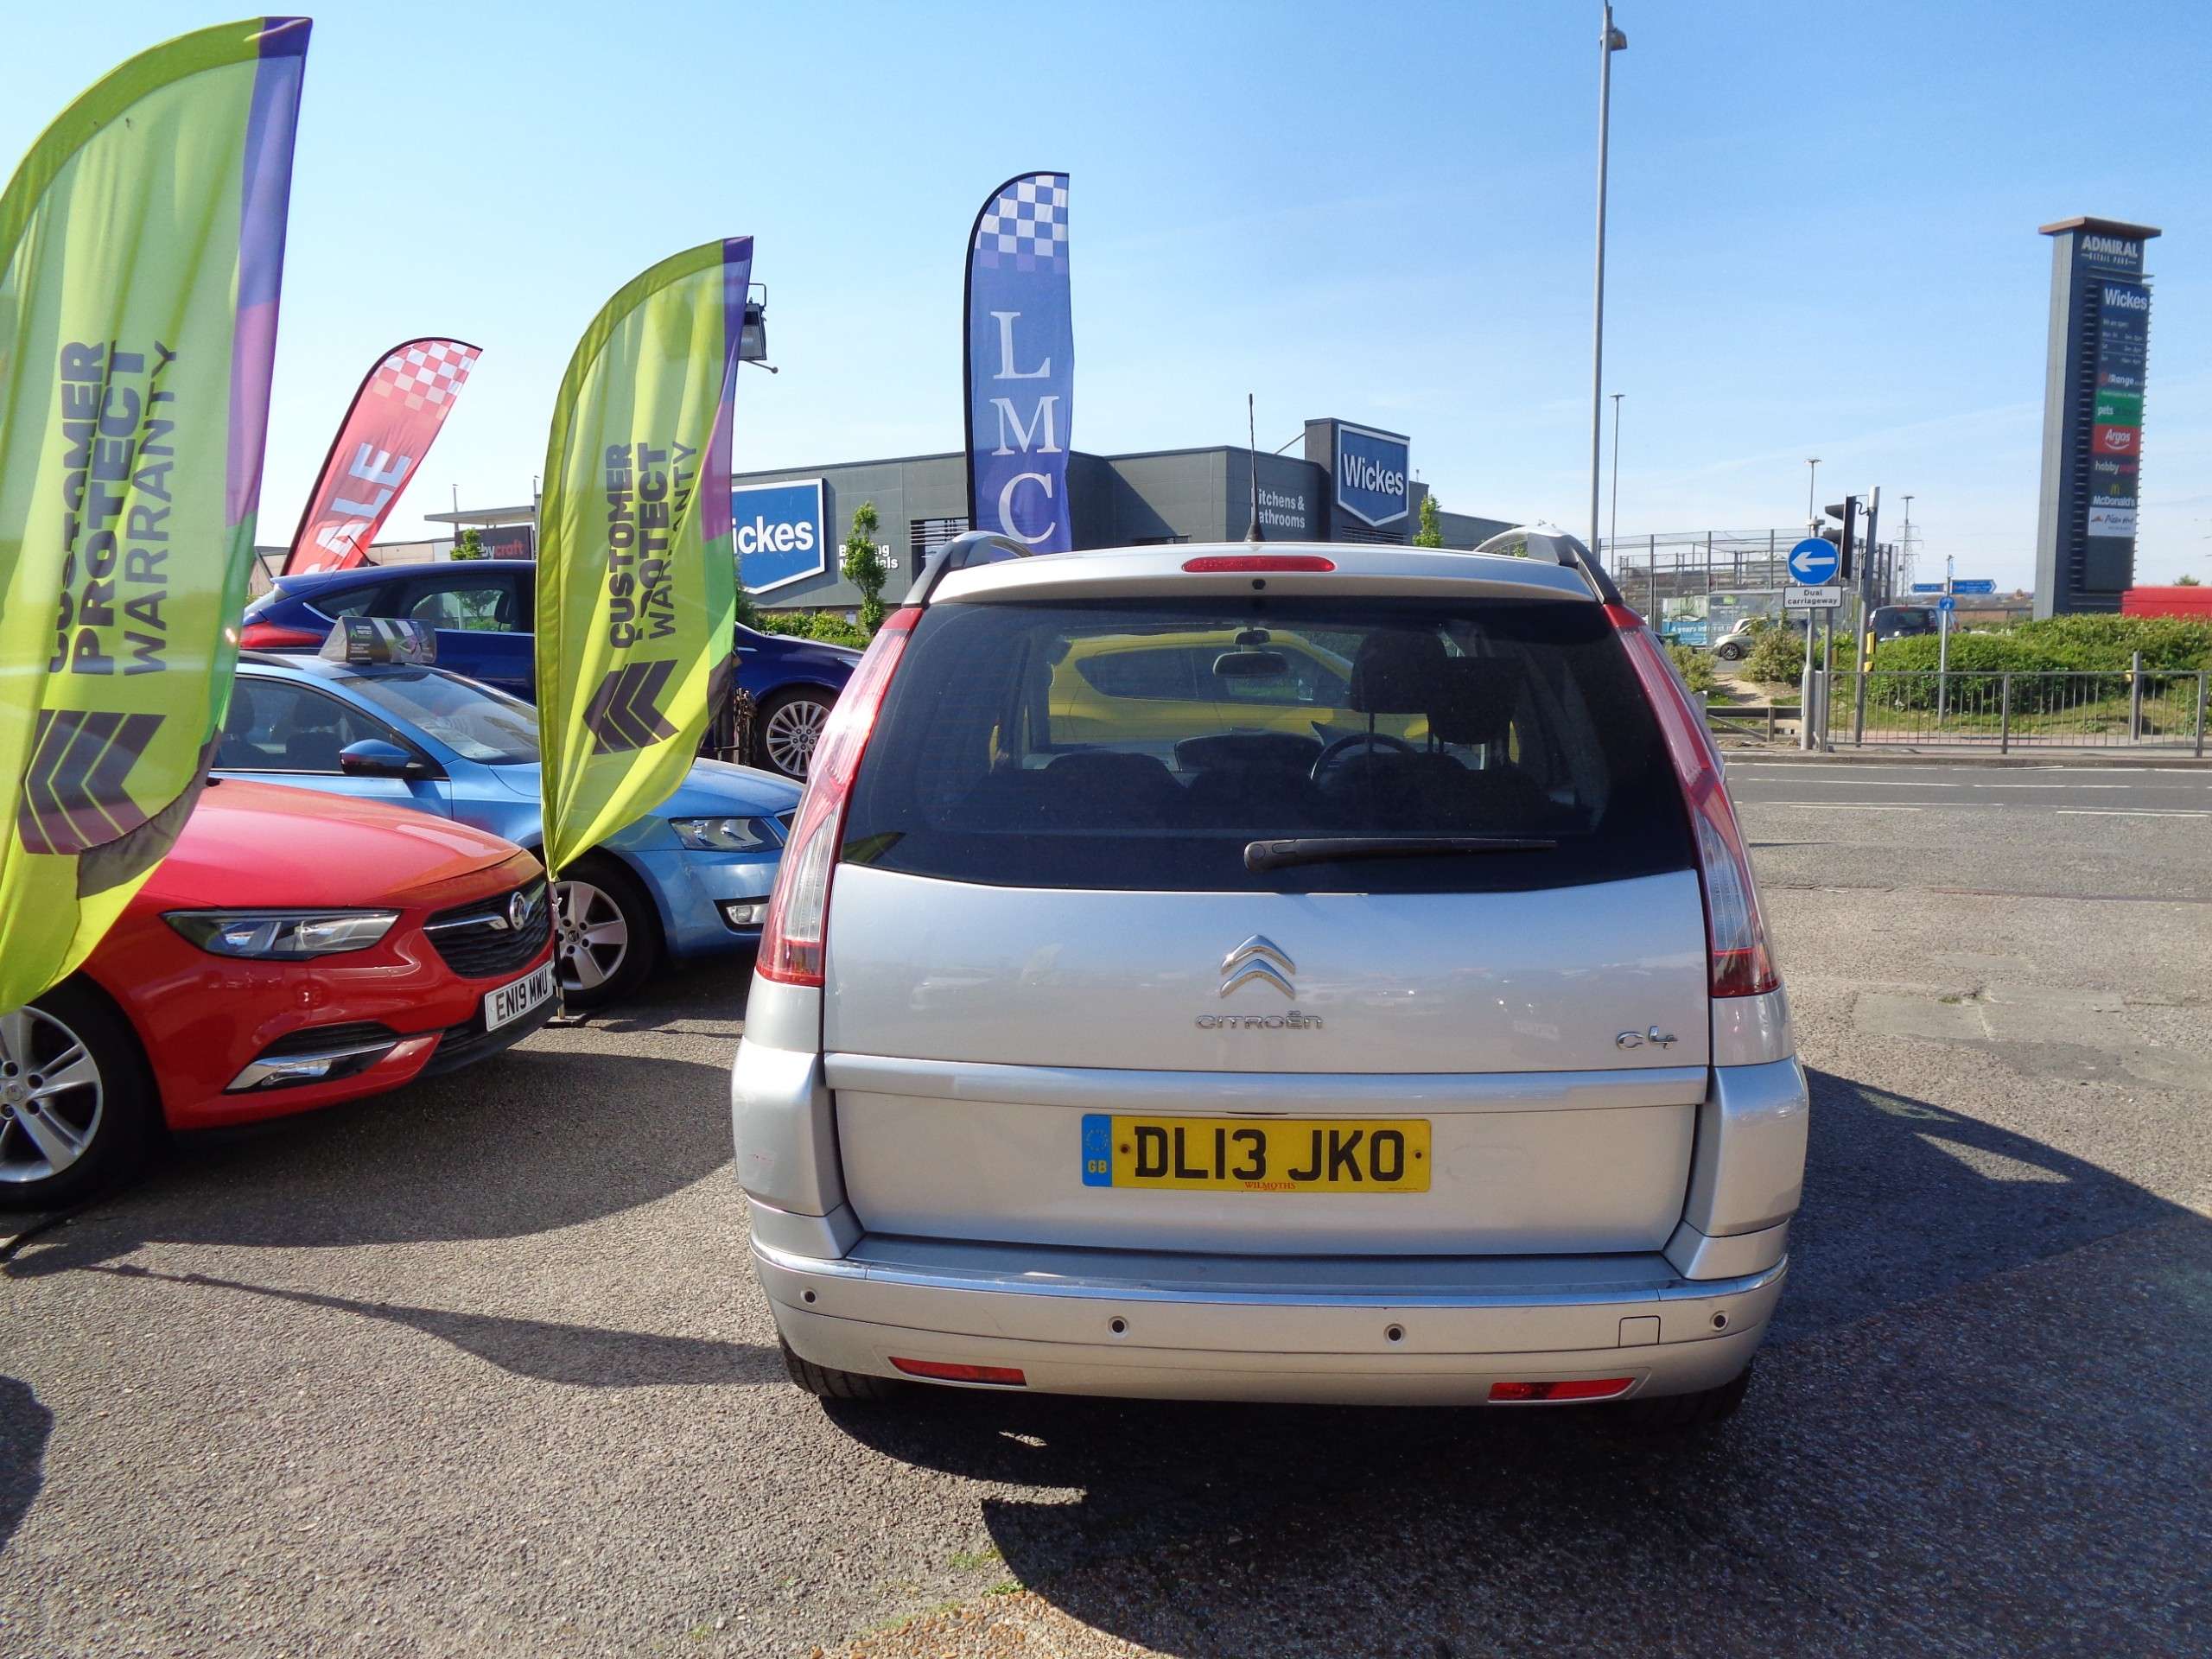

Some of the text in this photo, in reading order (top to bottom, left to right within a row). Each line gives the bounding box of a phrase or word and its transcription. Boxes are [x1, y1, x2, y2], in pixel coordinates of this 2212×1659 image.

[2081, 234, 2139, 258] ADMIRAL
[2104, 288, 2148, 310] Wickes
[2097, 405, 2113, 416] pets
[2105, 429, 2131, 445] Argos
[1343, 453, 1405, 496] Wickes
[72, 339, 144, 676] PROTECT
[124, 340, 177, 677] WARRANTY
[303, 442, 413, 574] ALE
[1251, 487, 1306, 512] itchens &
[2093, 495, 2136, 507] McDonald's
[1251, 507, 1306, 529] athrooms
[606, 442, 636, 649] CUSTOMER
[733, 516, 814, 555] ickes
[495, 969, 548, 1022] EN19 MWU
[1616, 1026, 1679, 1051] C4
[1134, 1126, 1405, 1182] DL13 JKO
[1087, 1160, 1107, 1174] GB
[1244, 1181, 1296, 1190] WILMOTHS
